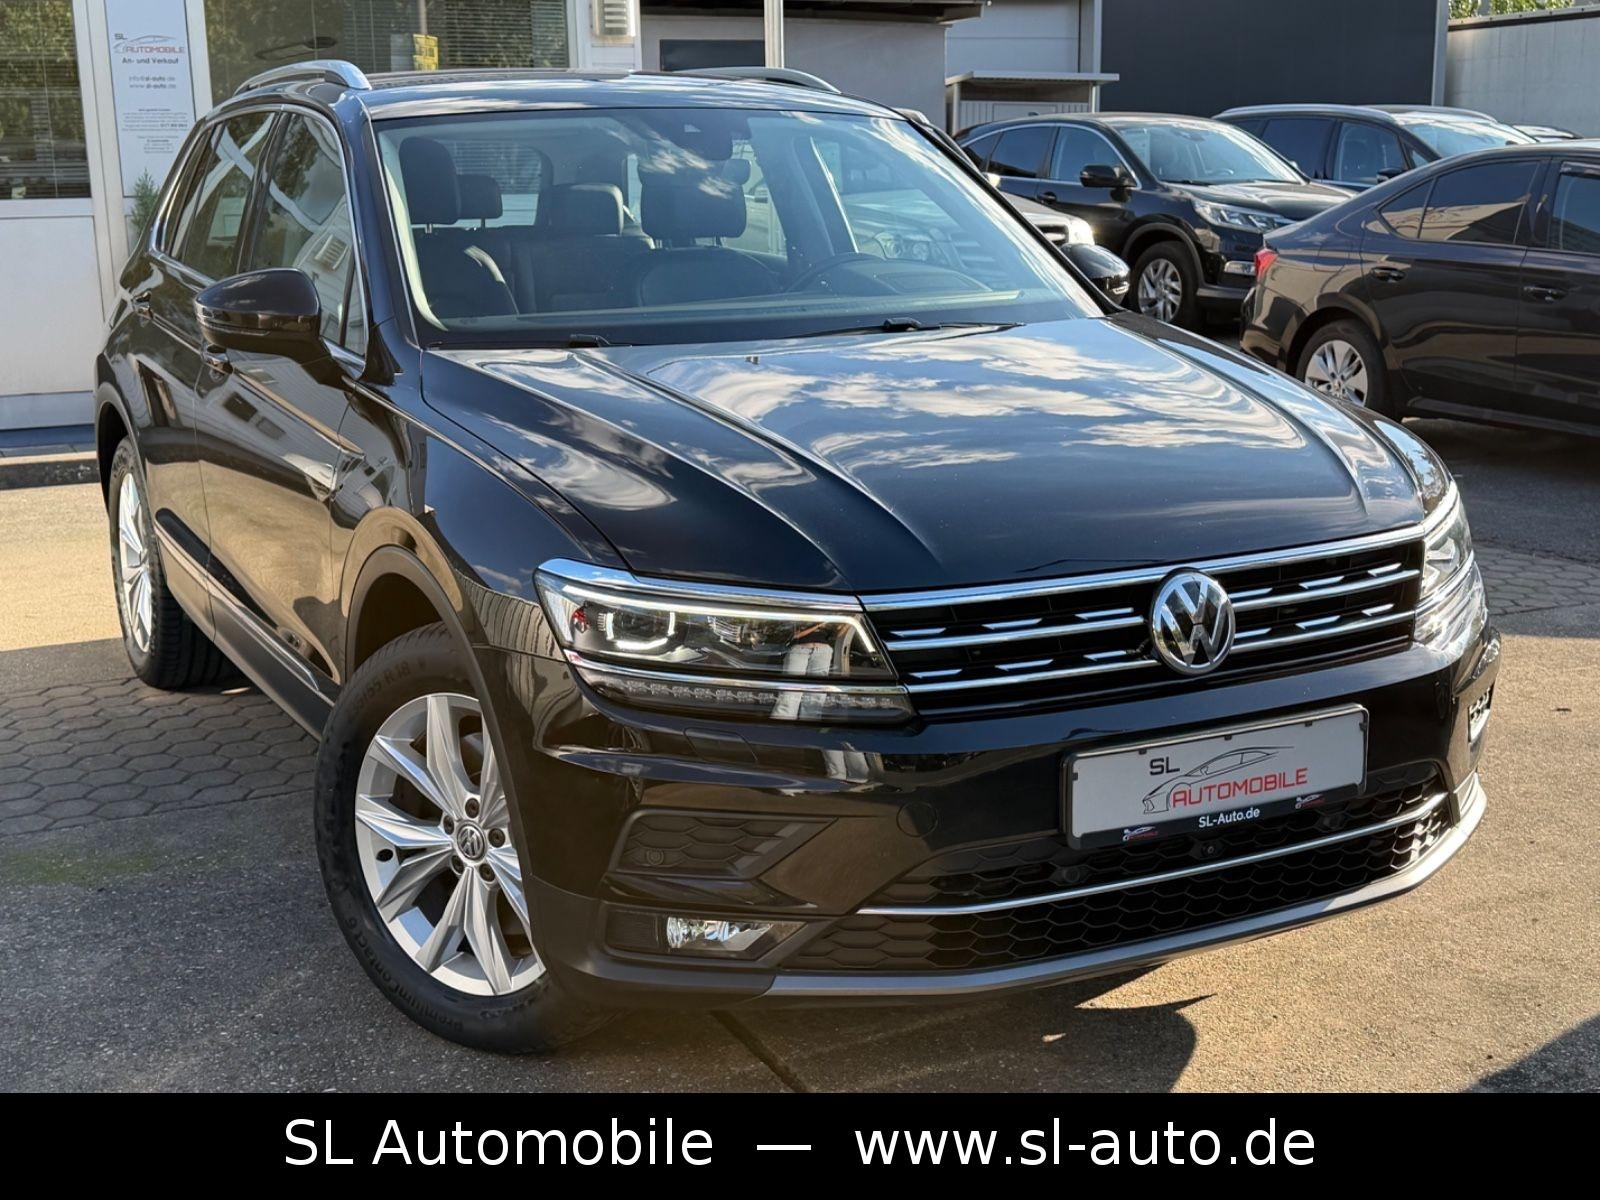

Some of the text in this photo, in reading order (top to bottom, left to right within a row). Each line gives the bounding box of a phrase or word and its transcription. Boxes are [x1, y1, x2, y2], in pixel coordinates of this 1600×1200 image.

[126, 46, 185, 54] AUTOMOBILE
[1149, 757, 1181, 776] SL
[1172, 767, 1309, 808] AUTOMOBILE
[1198, 807, 1261, 829] SL-Auto.de
